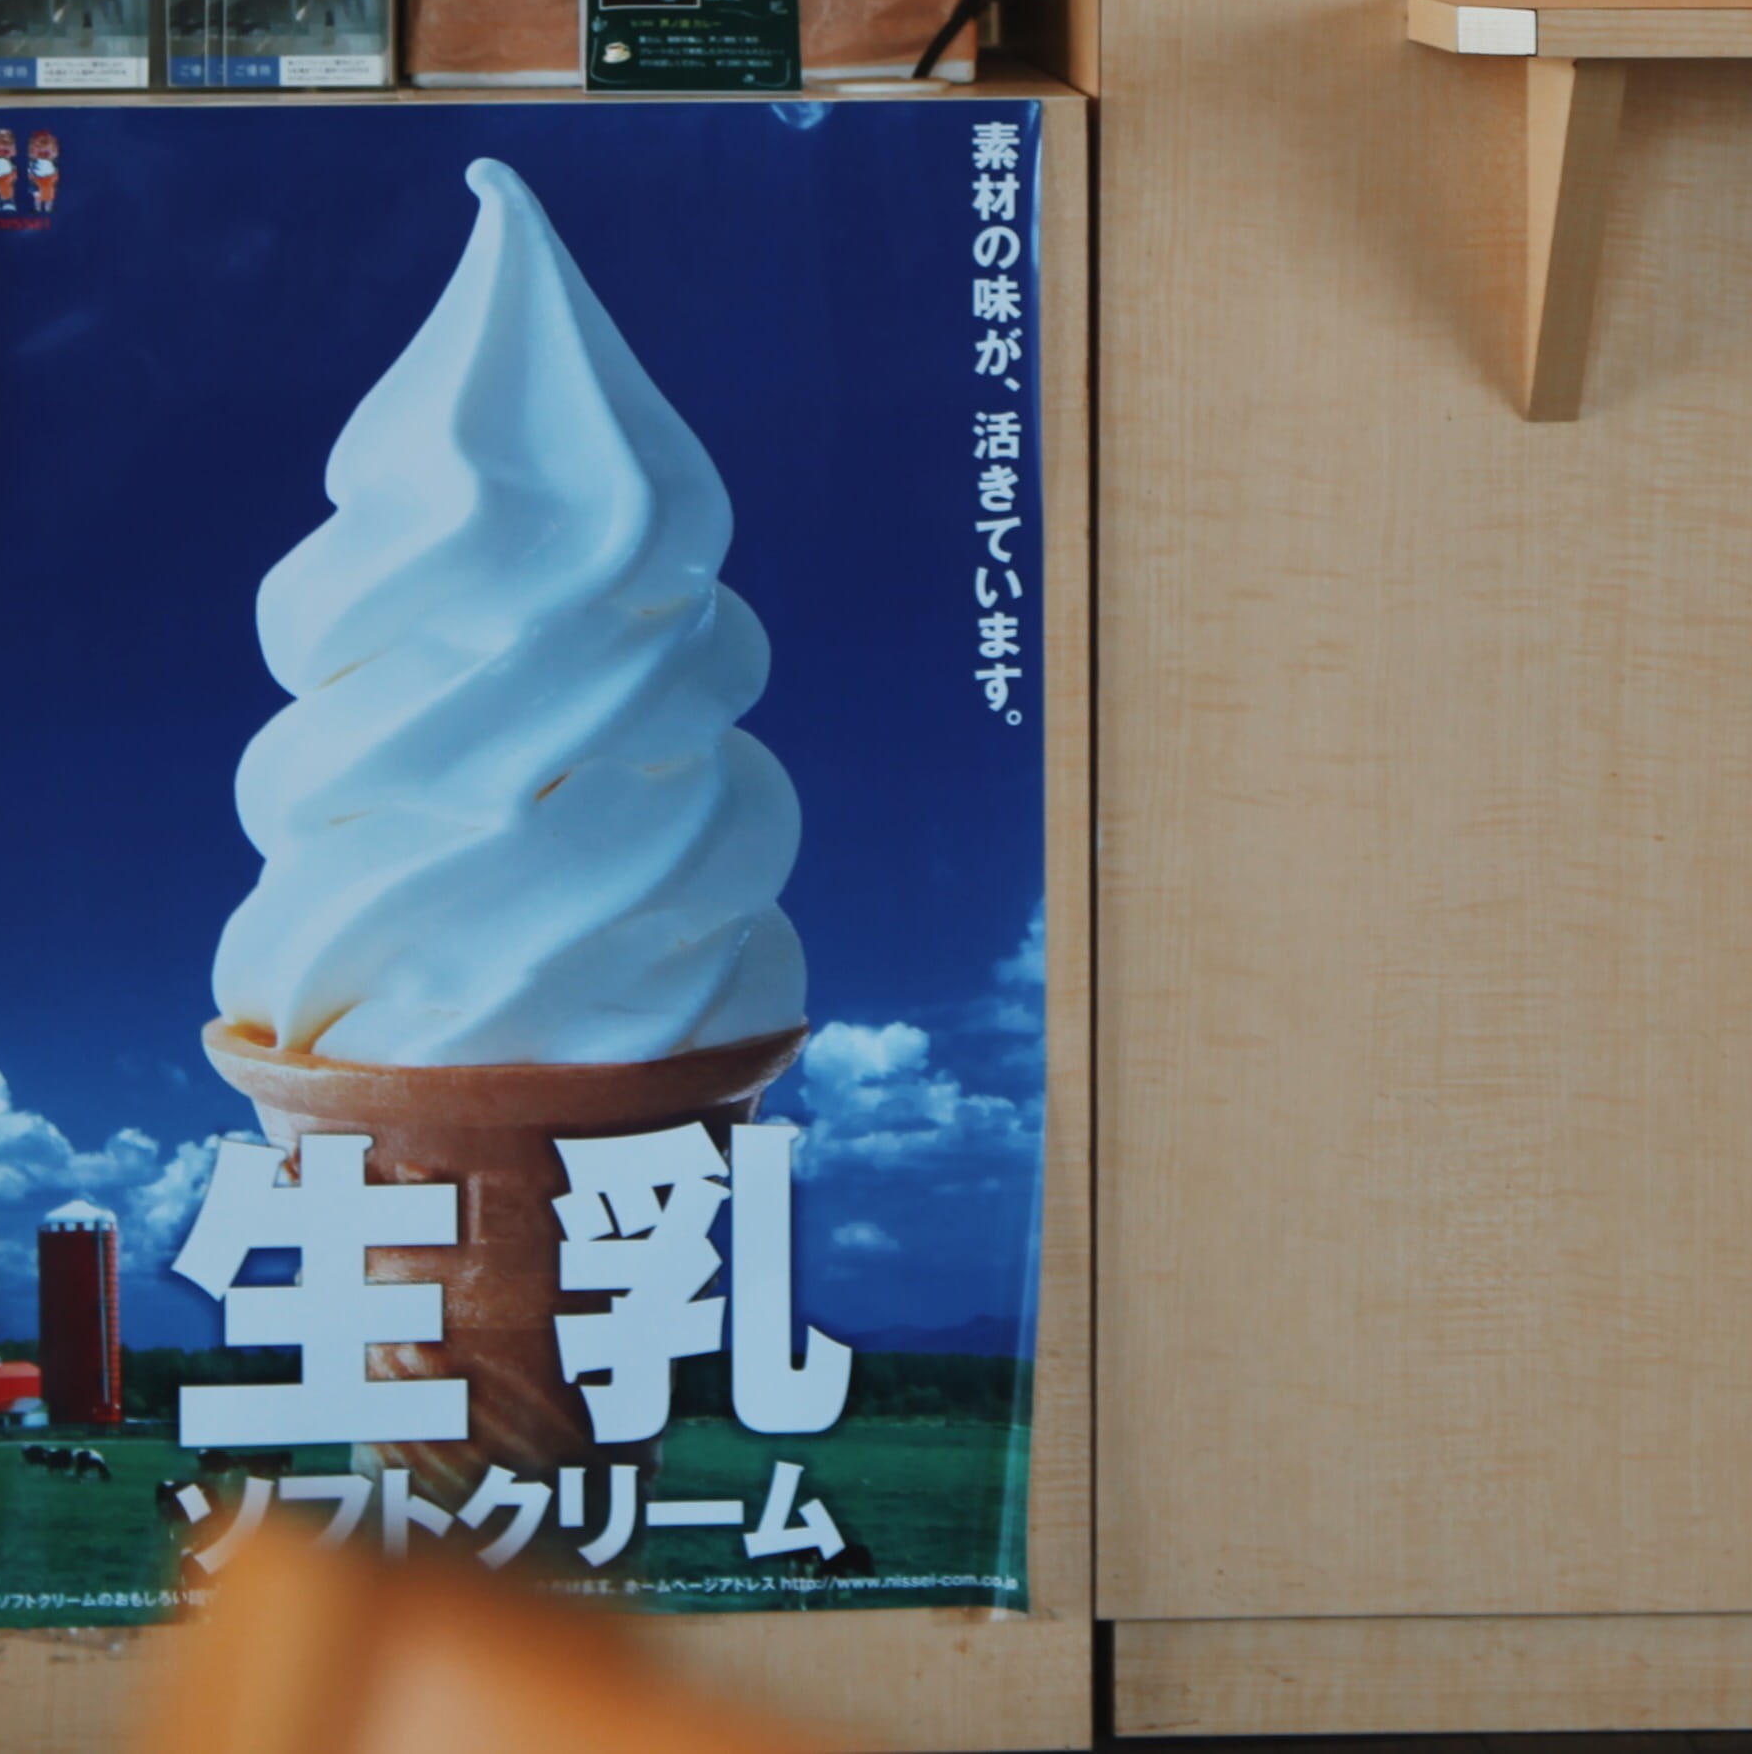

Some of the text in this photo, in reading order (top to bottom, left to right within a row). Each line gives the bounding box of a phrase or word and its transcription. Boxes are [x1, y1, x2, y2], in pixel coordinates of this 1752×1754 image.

[970, 120, 1025, 727] 素材の味が、活きています。
[172, 1119, 854, 1449] 生乳
[177, 1461, 845, 1574] ソフトクリーム
[624, 1571, 1020, 1594] ホームページアドレス http://www.nissei-com.co.jp
